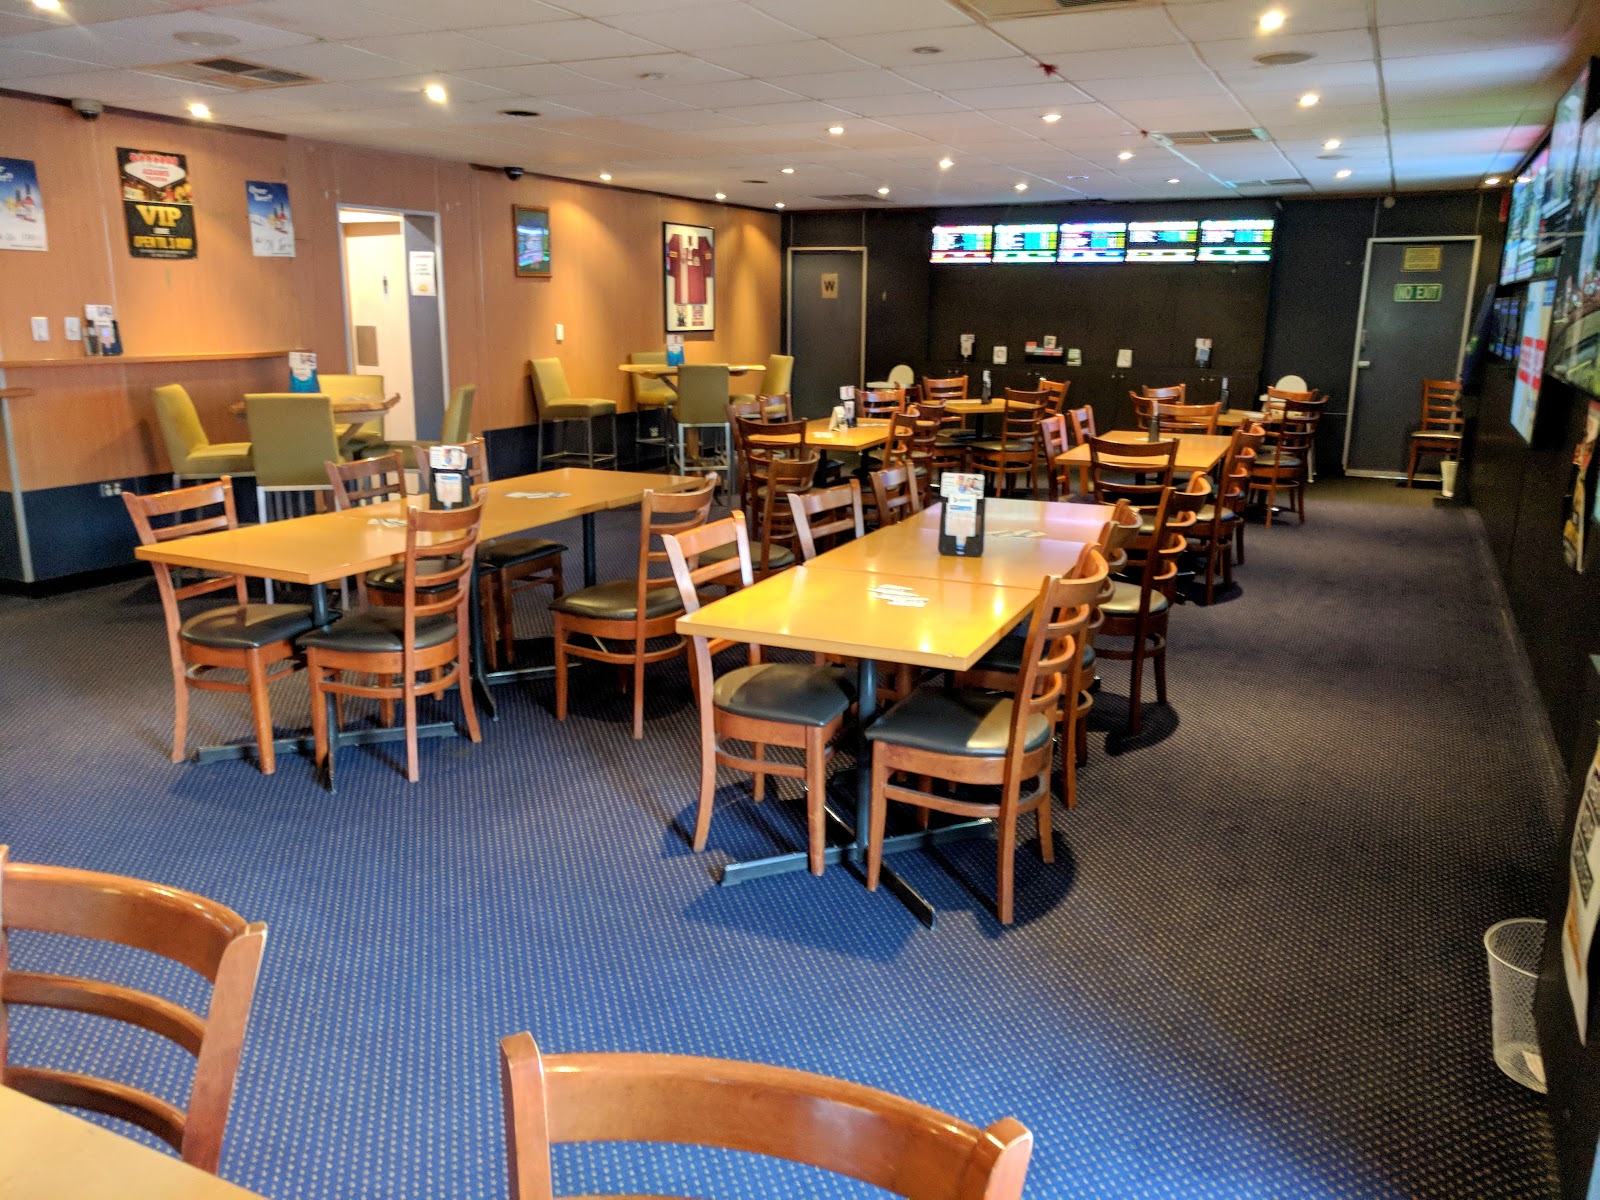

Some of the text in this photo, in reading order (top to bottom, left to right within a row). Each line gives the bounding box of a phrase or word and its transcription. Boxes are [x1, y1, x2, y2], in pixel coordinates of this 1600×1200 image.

[135, 205, 182, 227] VIP
[823, 280, 836, 292] W
[1397, 285, 1439, 299] NO EXIT
